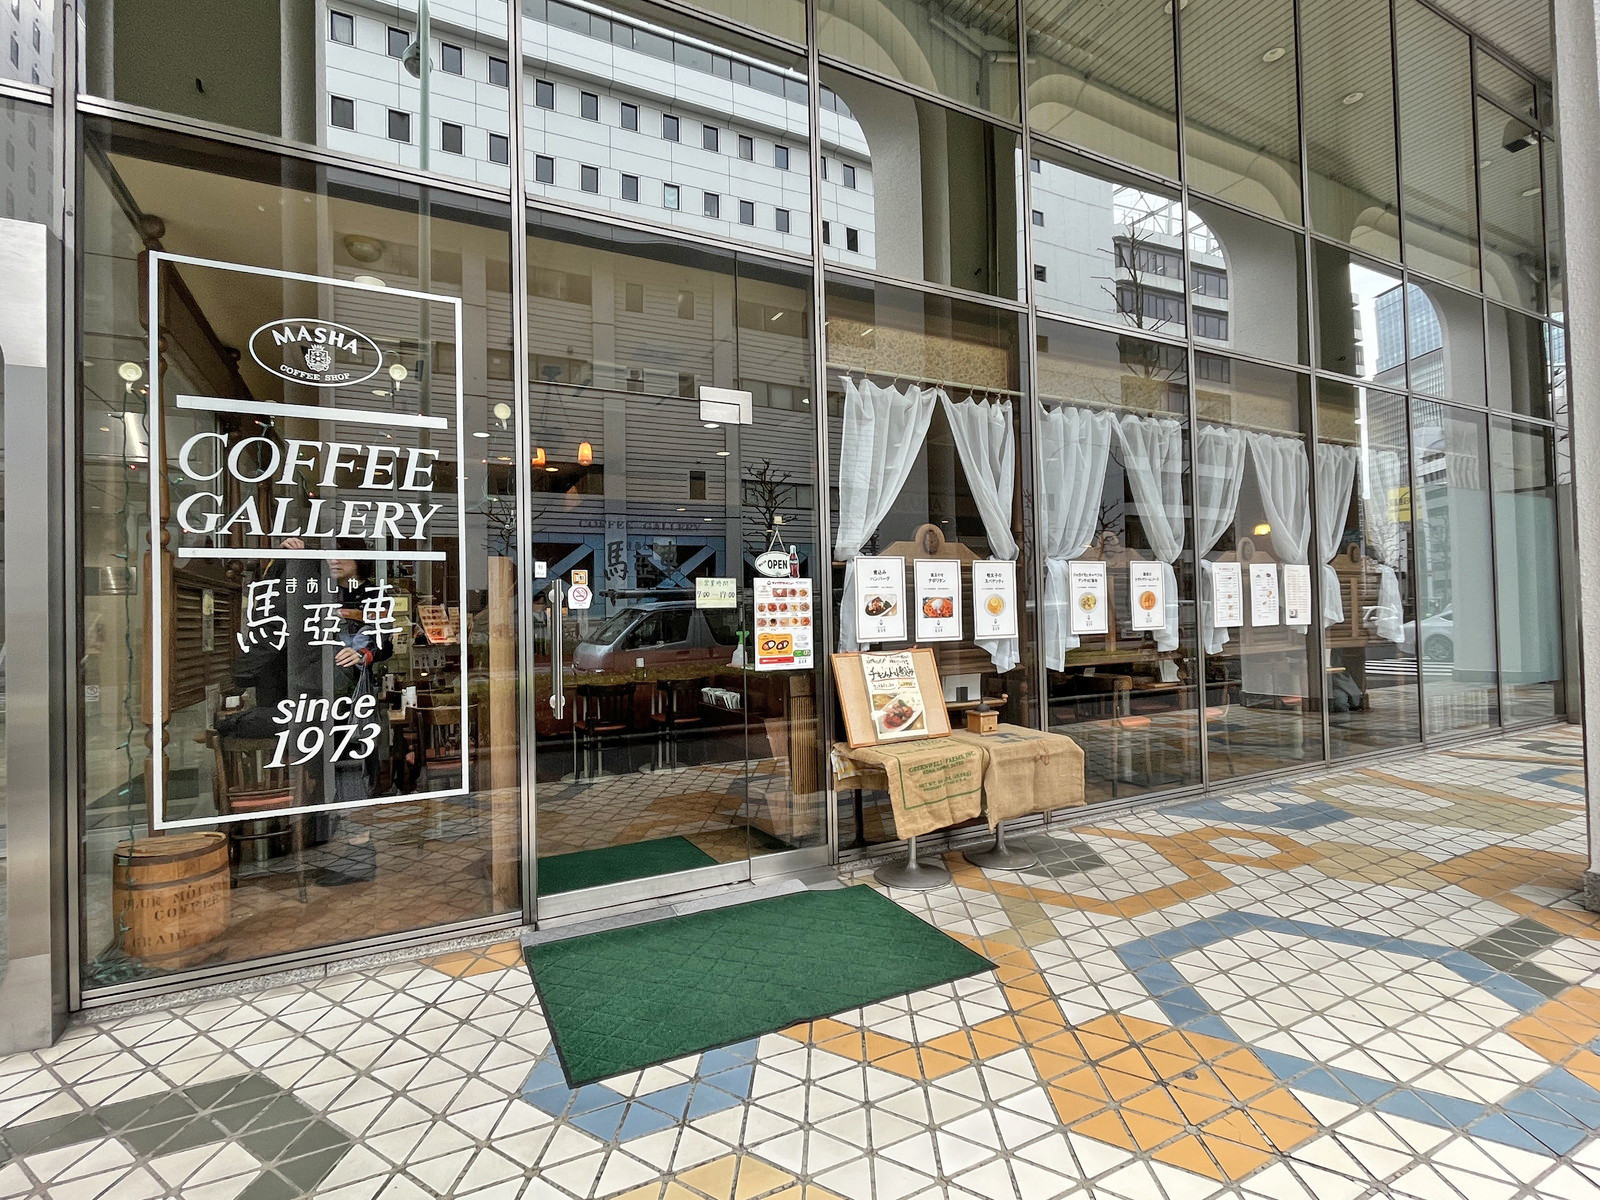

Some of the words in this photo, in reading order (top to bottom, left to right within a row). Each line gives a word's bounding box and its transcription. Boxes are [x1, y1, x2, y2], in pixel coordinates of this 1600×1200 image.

[272, 326, 358, 355] MASHA
[280, 364, 321, 381] COFFEE
[325, 373, 350, 382] SHOP
[178, 432, 440, 491] COFFEE
[176, 491, 443, 540] GALLERY
[768, 560, 787, 569] OPEN
[236, 577, 403, 654] 馬亞車
[271, 692, 376, 725] since
[263, 723, 382, 769] 1973
[909, 761, 942, 772] GREENWELL
[154, 895, 220, 922] COFFEE
